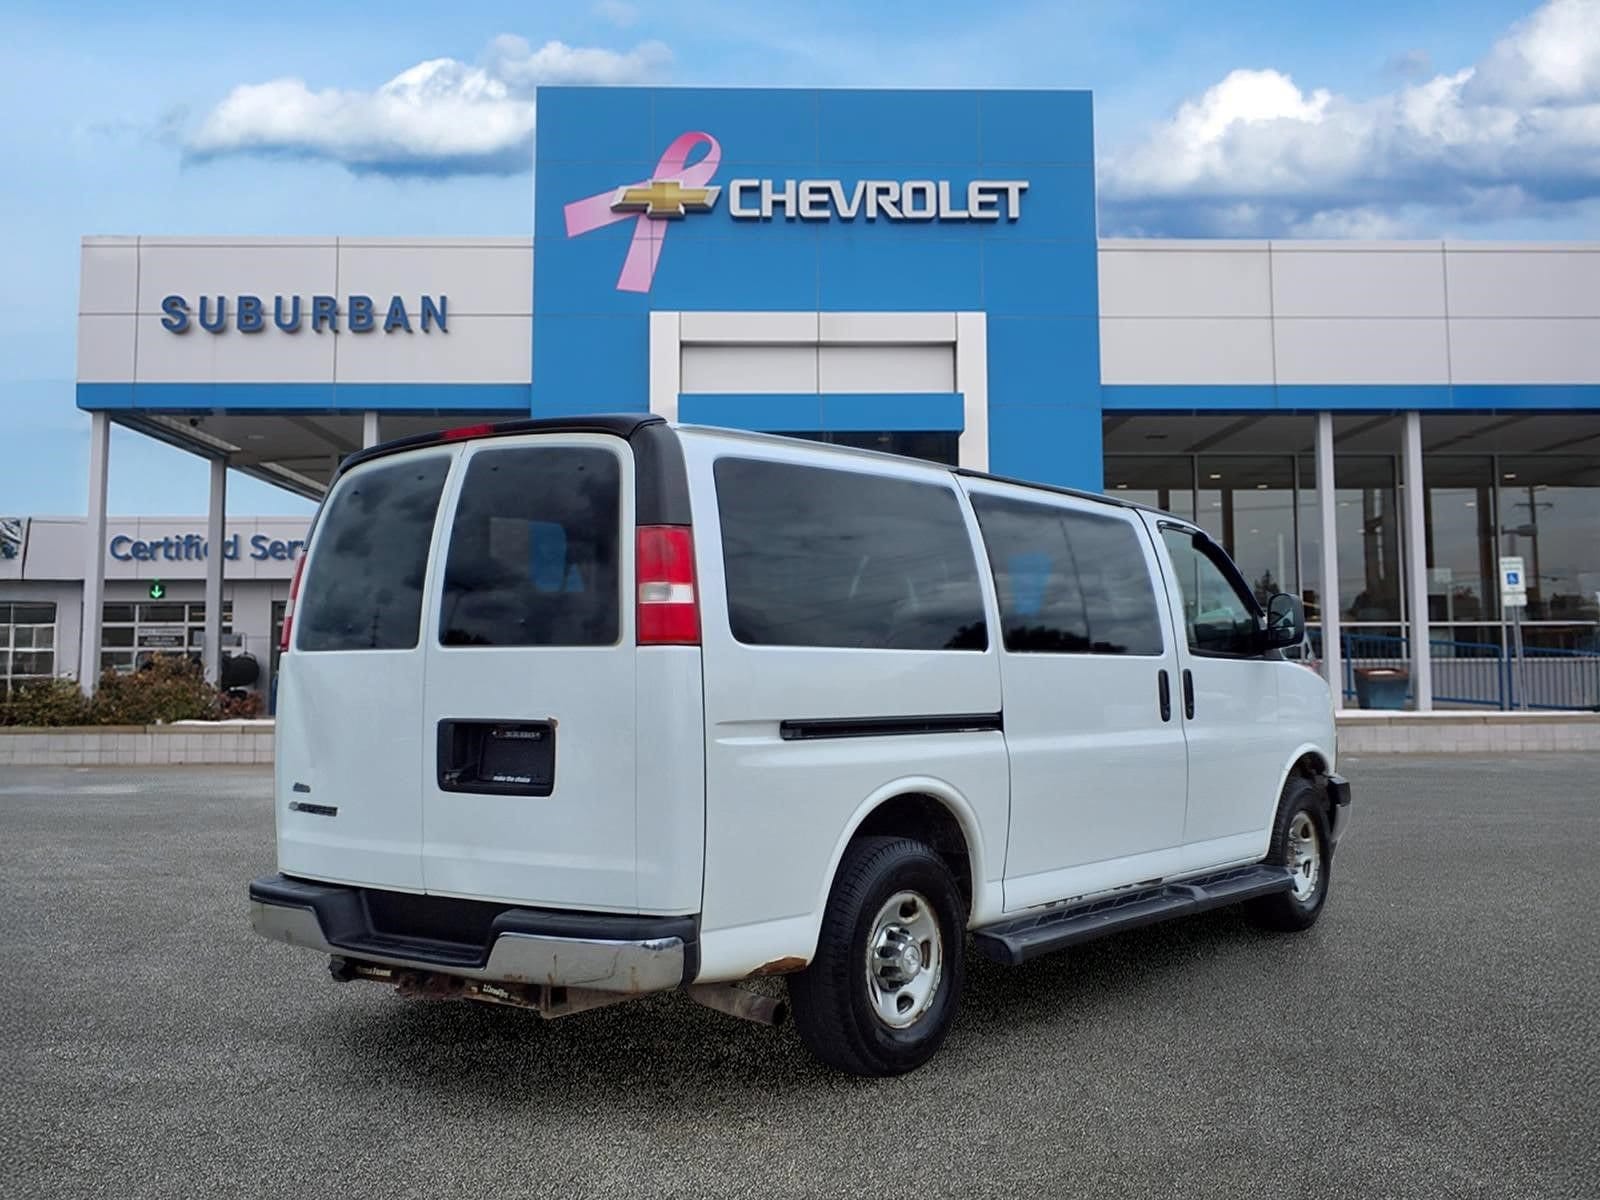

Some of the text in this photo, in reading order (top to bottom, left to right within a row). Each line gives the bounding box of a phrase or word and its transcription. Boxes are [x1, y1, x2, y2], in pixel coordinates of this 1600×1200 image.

[728, 178, 1029, 222] CHEVROLET
[160, 295, 449, 334] SUBURBAN
[110, 533, 240, 561] Certifid
